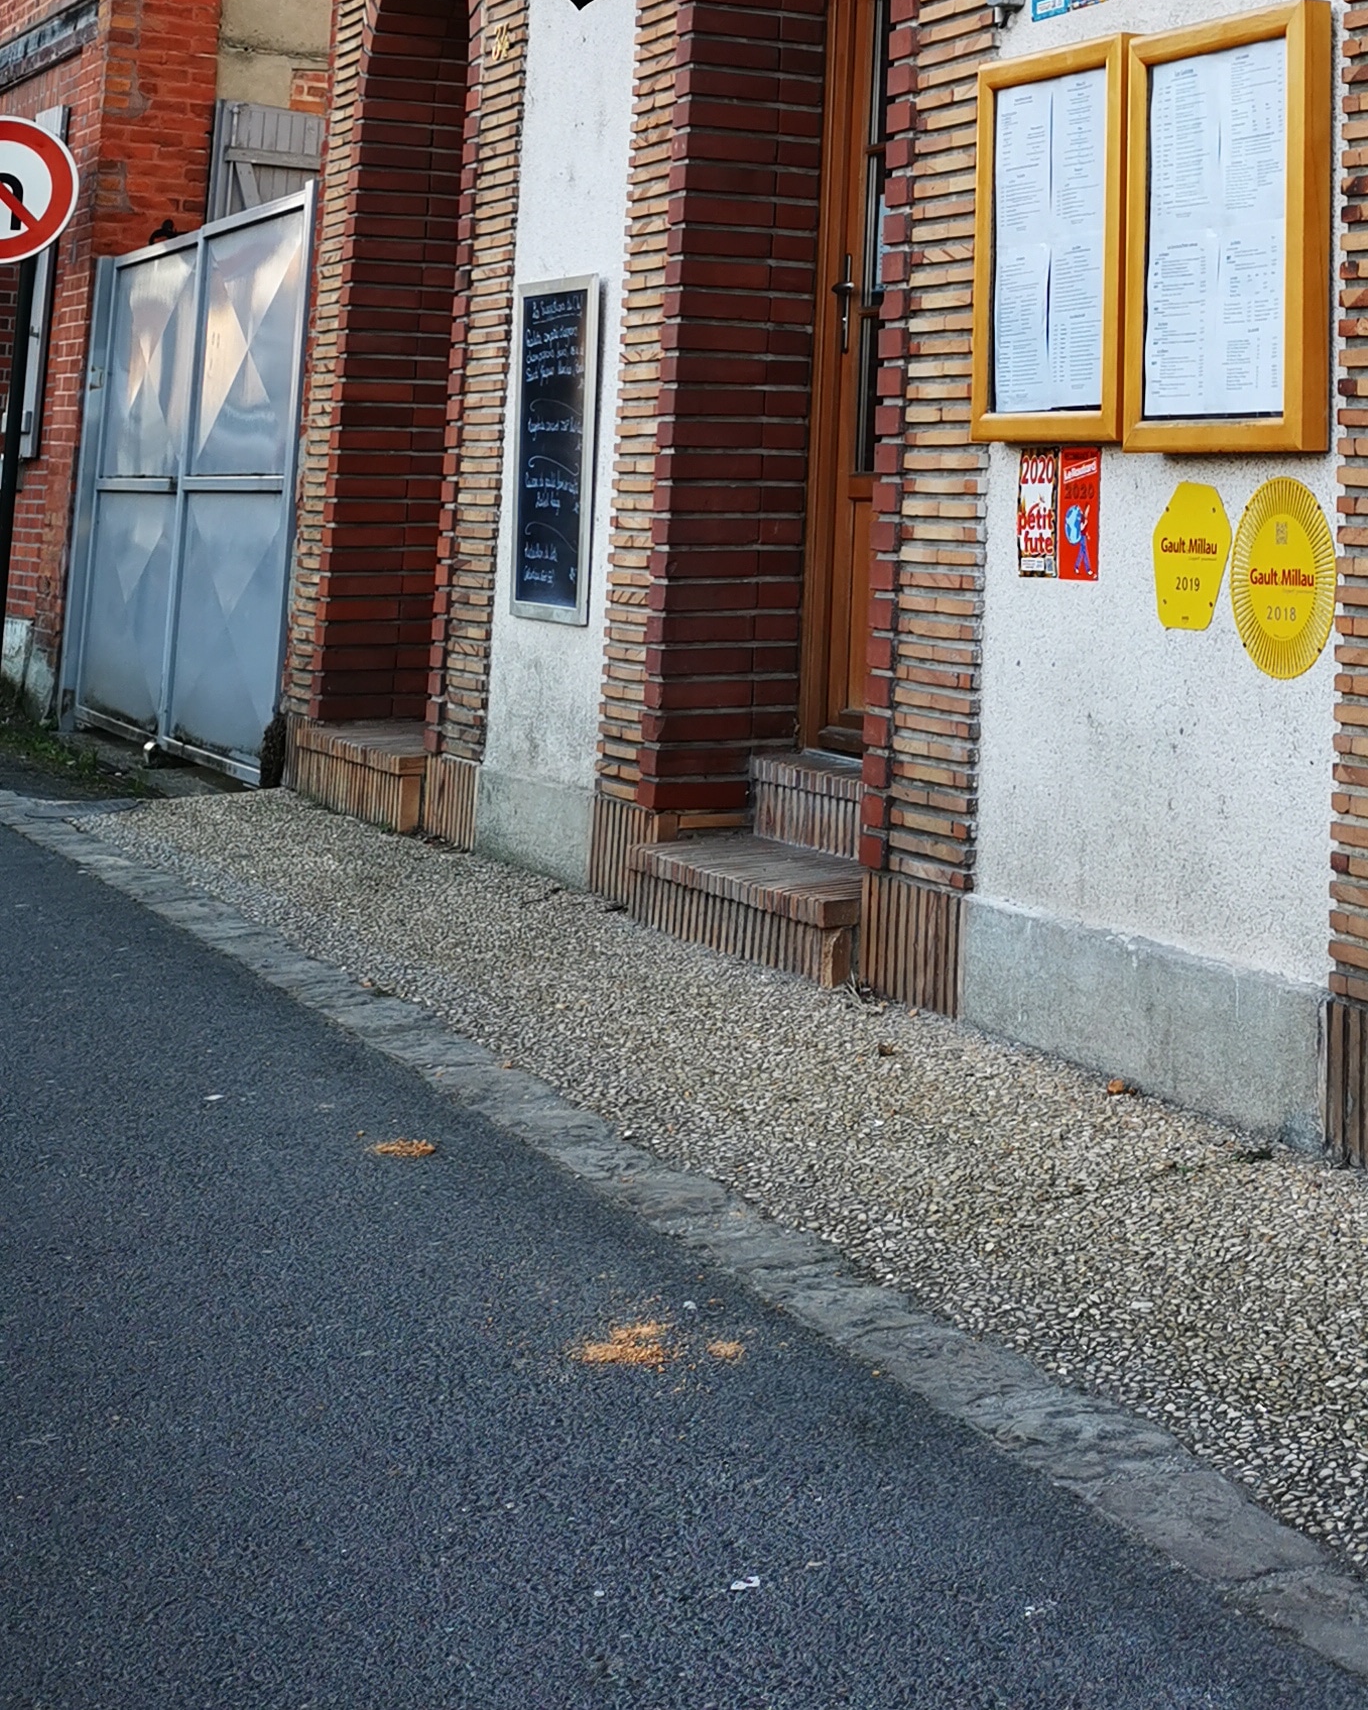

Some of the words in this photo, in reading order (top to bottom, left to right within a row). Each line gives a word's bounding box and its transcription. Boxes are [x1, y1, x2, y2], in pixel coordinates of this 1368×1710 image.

[1020, 455, 1055, 484] 2020
[1175, 576, 1200, 592] 2019
[1266, 605, 1297, 622] 2018
